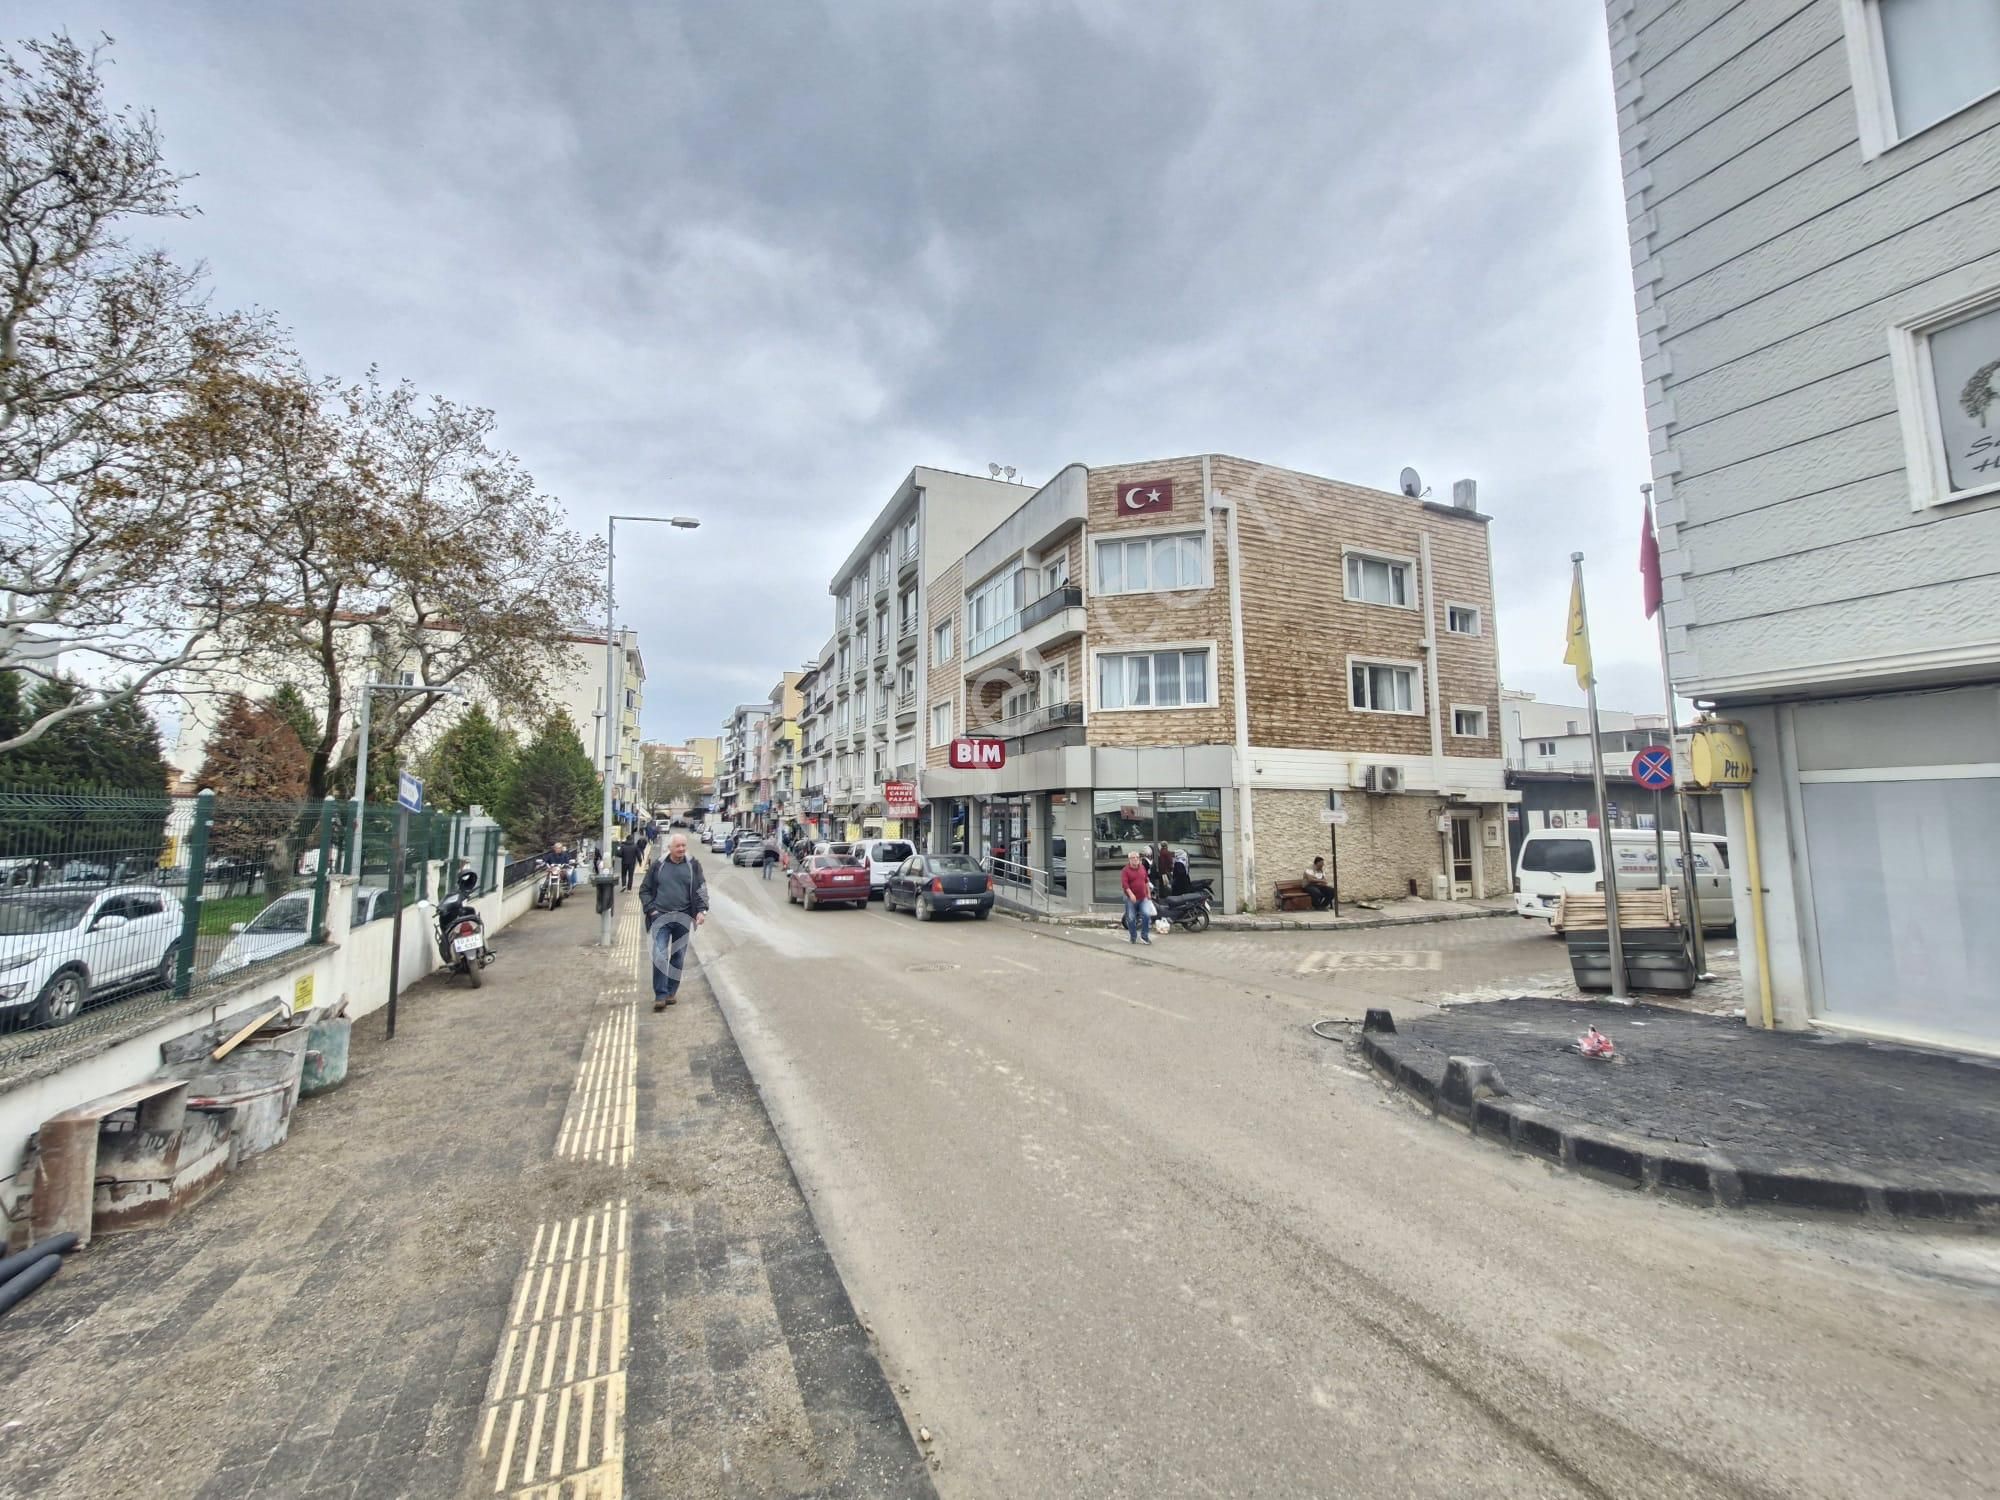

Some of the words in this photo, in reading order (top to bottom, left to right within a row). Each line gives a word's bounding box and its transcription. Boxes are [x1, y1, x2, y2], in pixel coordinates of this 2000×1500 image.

[1964, 435, 2000, 458] S
[957, 740, 1001, 763] BİM
[1724, 759, 1739, 778] Ptt
